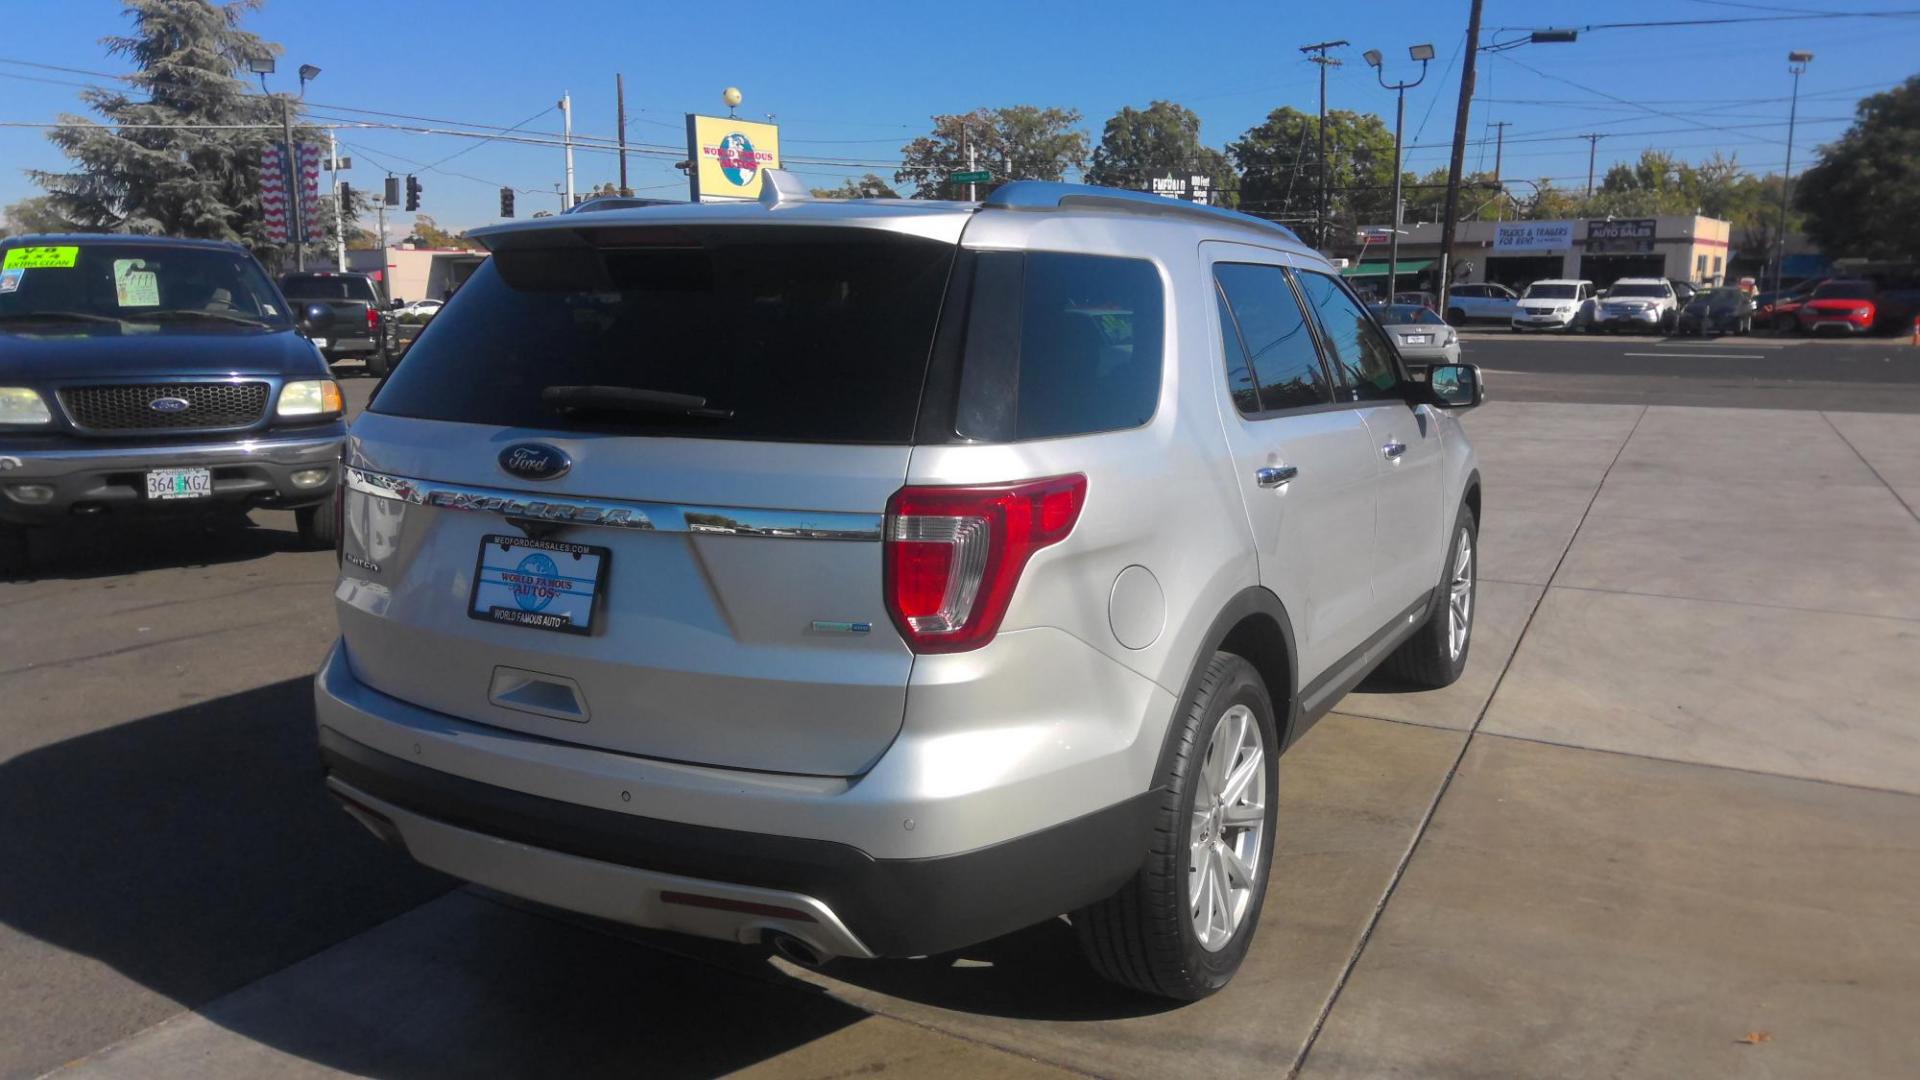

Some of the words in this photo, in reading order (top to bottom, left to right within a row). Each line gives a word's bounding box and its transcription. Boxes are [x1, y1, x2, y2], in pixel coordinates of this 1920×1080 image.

[1593, 228, 1617, 237] AUTO
[509, 447, 548, 471] Ford
[149, 478, 174, 493] 364
[183, 475, 209, 491] KGZ
[428, 491, 632, 524] EXPLORER
[494, 535, 590, 554] MEDFORDCARSALES.COM
[501, 572, 534, 584] WORLD
[535, 576, 573, 589] FAMOUS
[515, 584, 556, 599] AUTOS
[494, 609, 516, 620] WORLD
[517, 611, 543, 624] FAMOUS
[543, 616, 561, 627] AUTO
